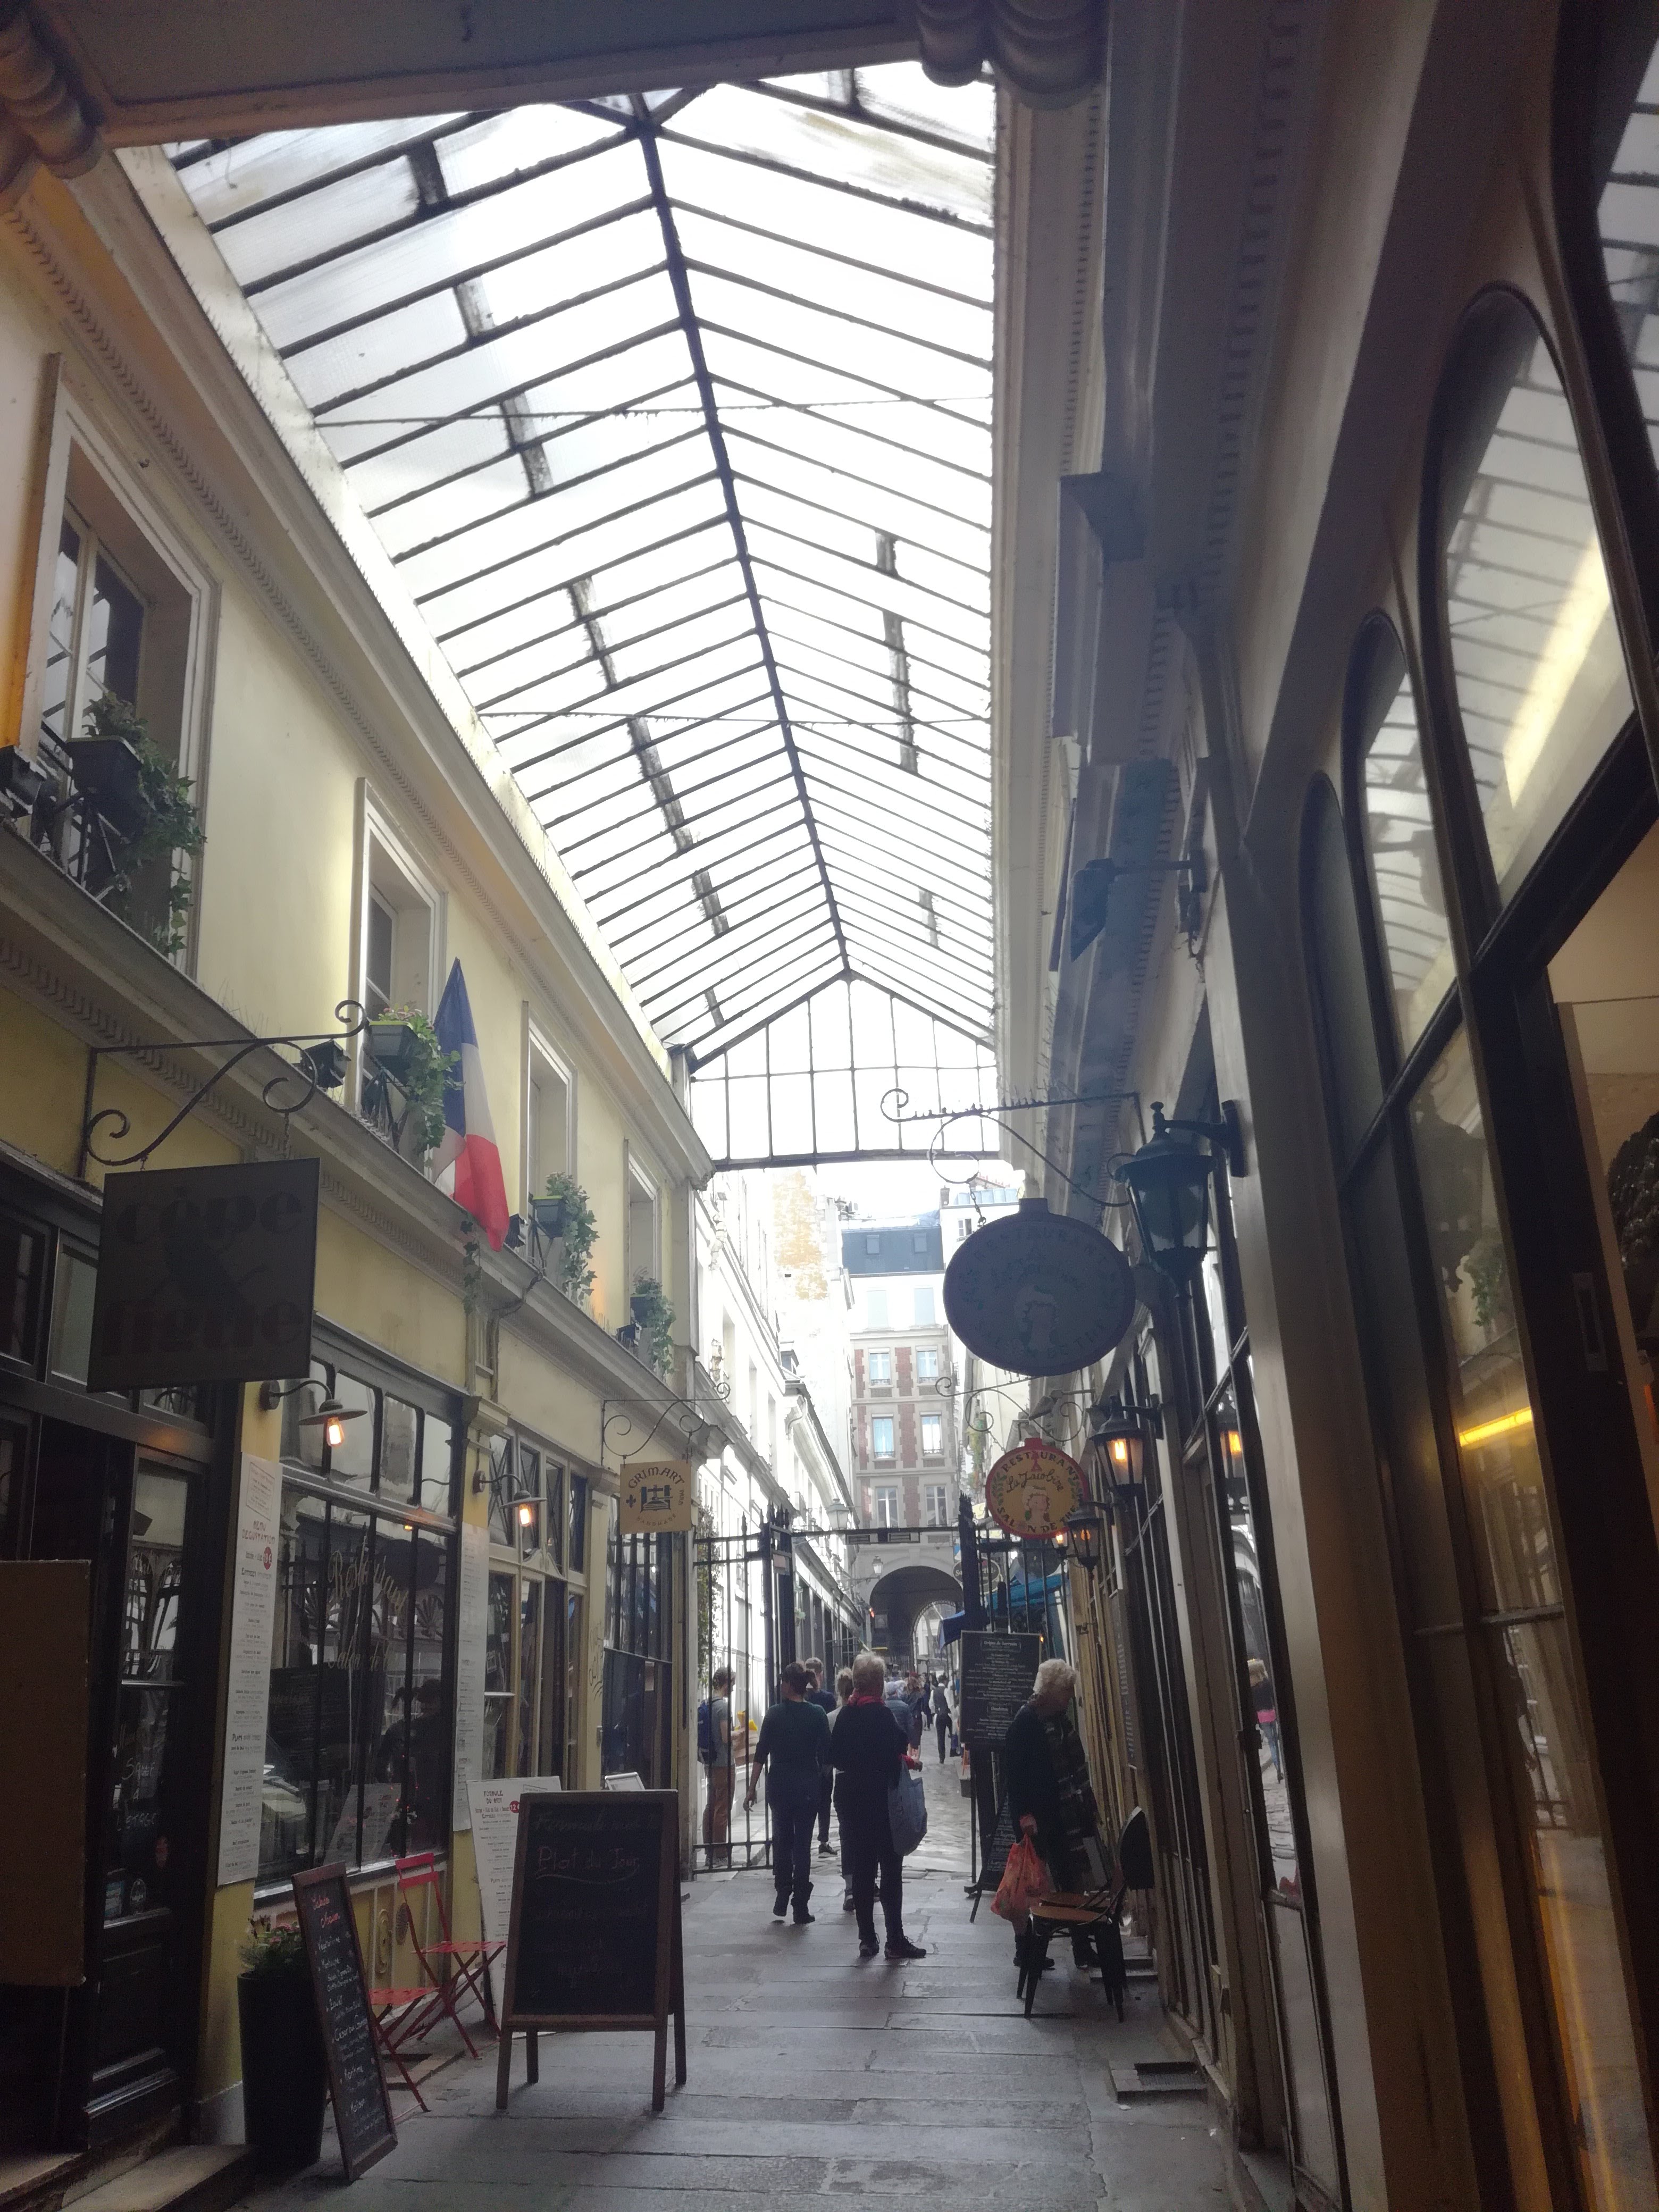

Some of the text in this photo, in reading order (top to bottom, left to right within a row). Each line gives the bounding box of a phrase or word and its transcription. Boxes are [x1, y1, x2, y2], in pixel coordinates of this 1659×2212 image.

[628, 1467, 685, 1489] GRIMART
[1007, 1468, 1064, 1493] La Jacobine
[637, 1513, 676, 1527] HANDMADE
[1041, 1522, 1057, 1531] DE
[535, 1845, 640, 1873] Plat du Jour
